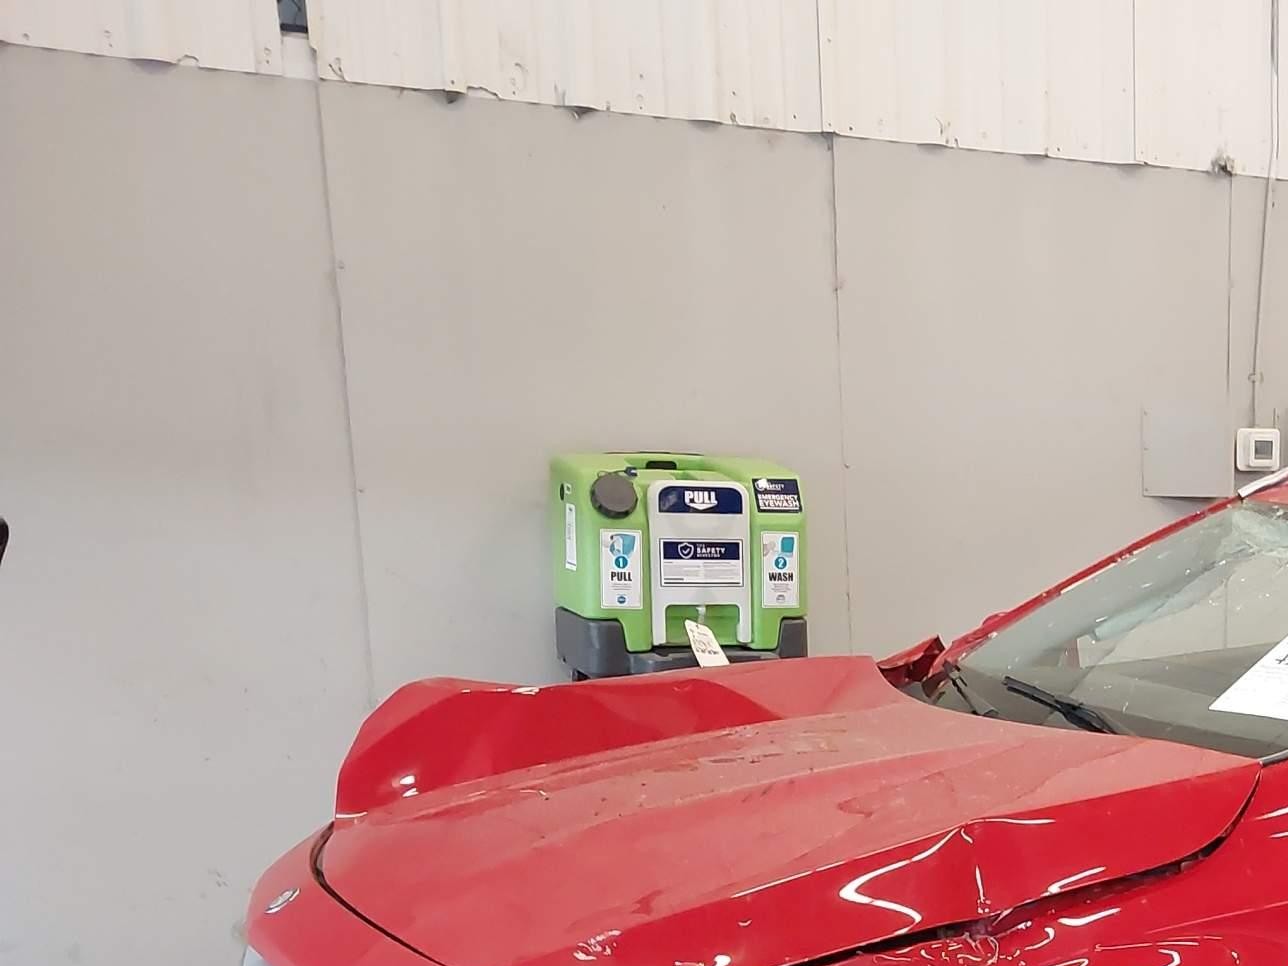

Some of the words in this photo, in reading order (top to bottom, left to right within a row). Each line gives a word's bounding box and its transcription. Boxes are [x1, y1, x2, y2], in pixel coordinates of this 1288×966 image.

[684, 490, 718, 504] PULL
[757, 493, 798, 501] EMERGENCY
[759, 500, 800, 508] EYEWASH
[778, 558, 785, 569] 2
[611, 571, 632, 582] PULL
[768, 572, 794, 582] WASH
